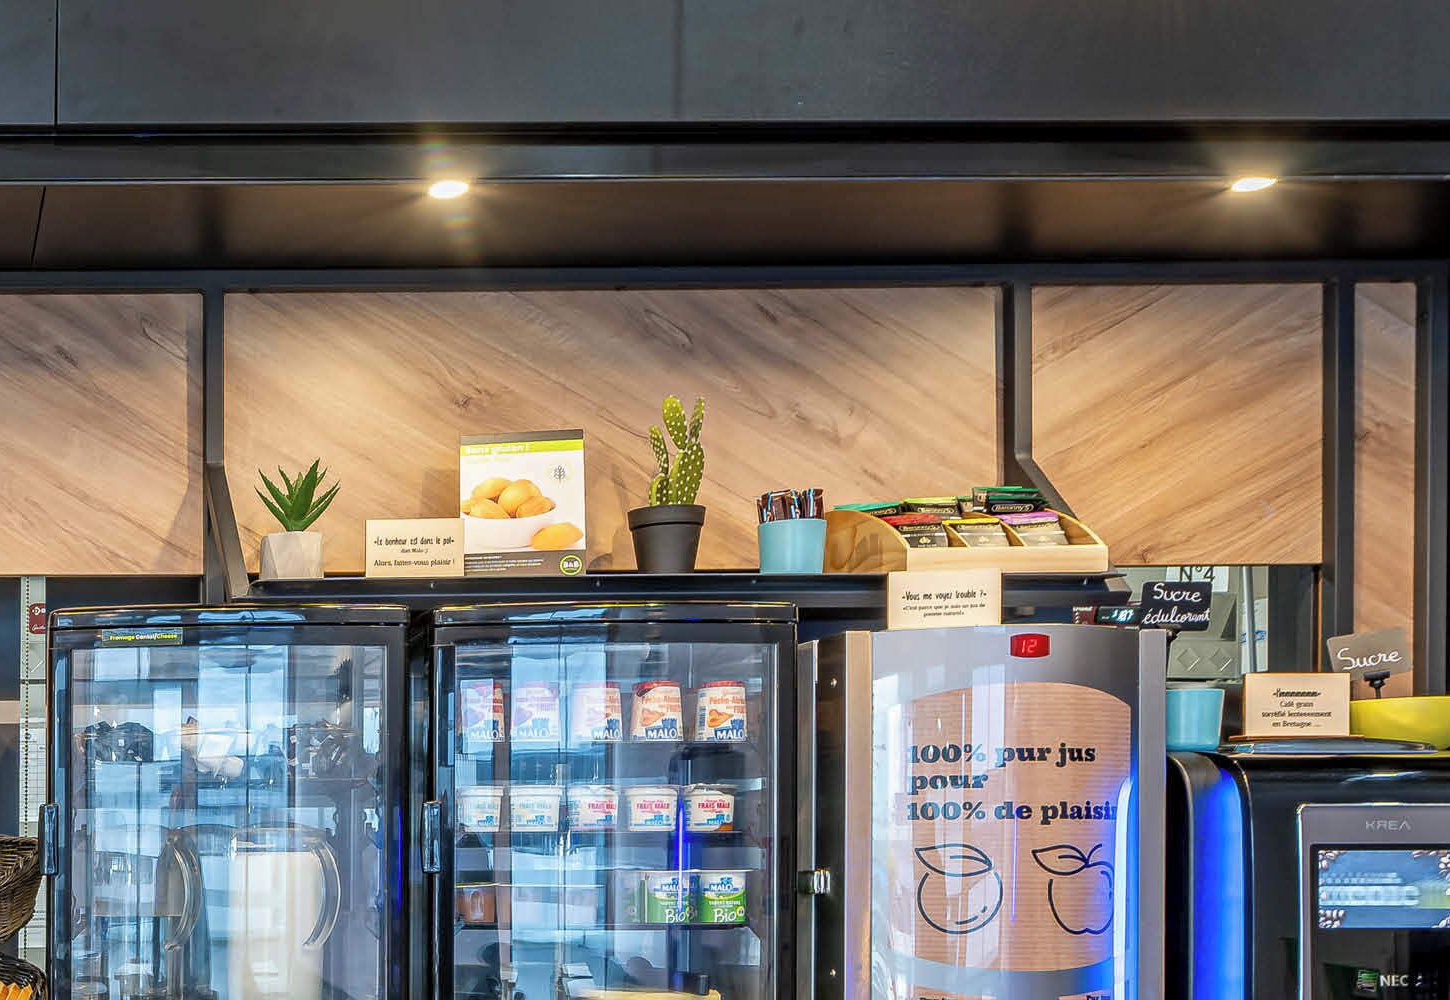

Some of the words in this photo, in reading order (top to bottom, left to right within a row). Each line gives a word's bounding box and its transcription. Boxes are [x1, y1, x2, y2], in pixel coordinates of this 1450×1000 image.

[1152, 582, 1203, 603] Sucre
[1141, 605, 1210, 625] édulcorant
[1021, 639, 1038, 654] 12
[1337, 648, 1402, 671] Sucre
[647, 728, 678, 739] MALO
[717, 729, 745, 740] MALO
[908, 744, 986, 763] 100%
[994, 746, 1052, 768] pur
[1055, 742, 1097, 767] jus
[907, 773, 989, 796] pour
[907, 801, 986, 821] 100%
[994, 801, 1032, 820] de
[710, 883, 732, 891] MALO
[665, 908, 685, 923] Bio
[714, 908, 737, 923] Bio
